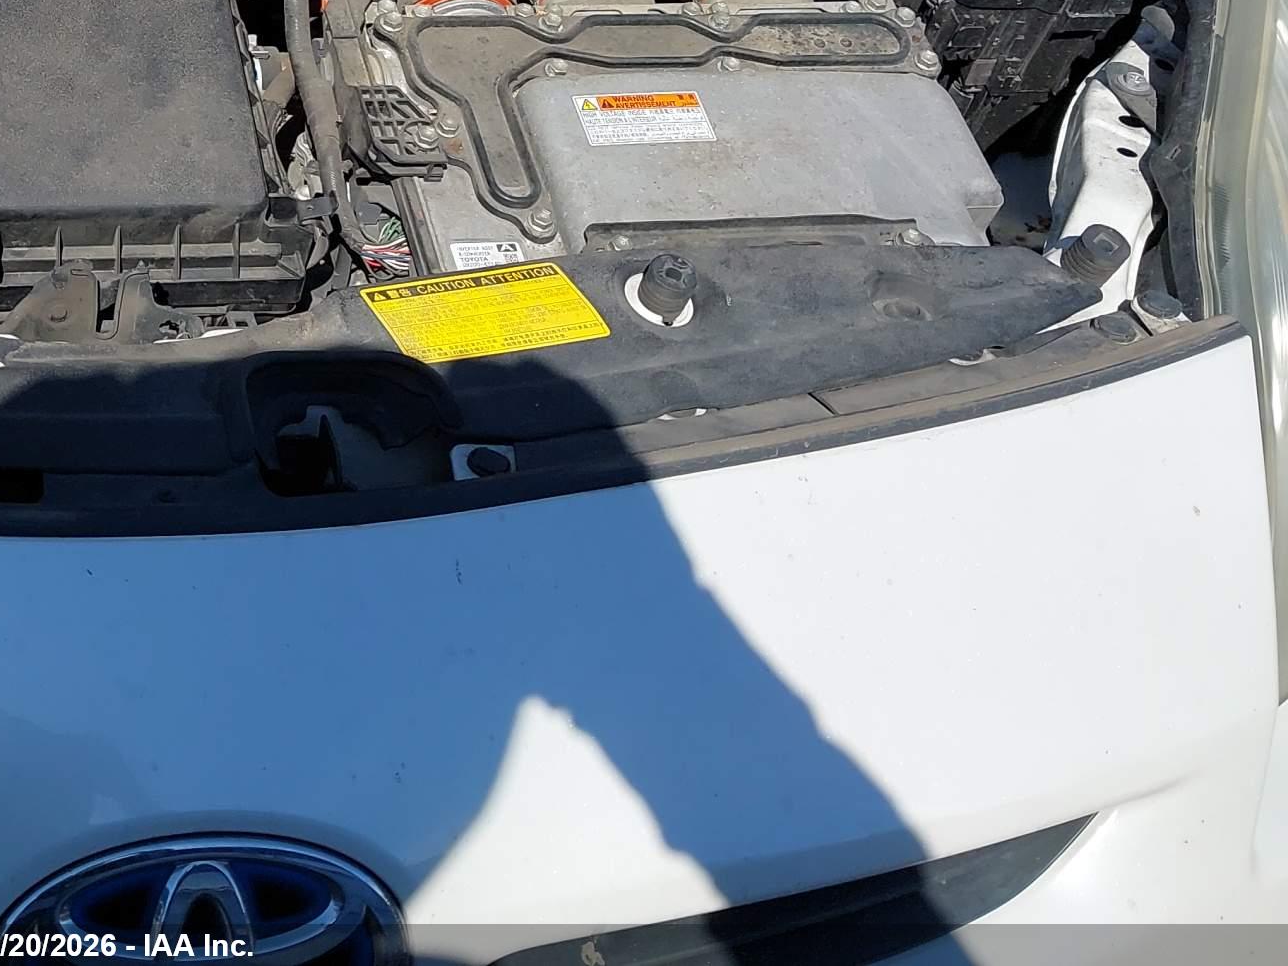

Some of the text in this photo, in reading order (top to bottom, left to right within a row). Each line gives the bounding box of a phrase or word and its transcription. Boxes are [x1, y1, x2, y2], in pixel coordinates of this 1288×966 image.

[613, 94, 655, 102] WARNING
[615, 100, 677, 109] AVERTISSEMENT
[416, 278, 474, 295] CAUTION
[480, 266, 555, 285] ATTENTION
